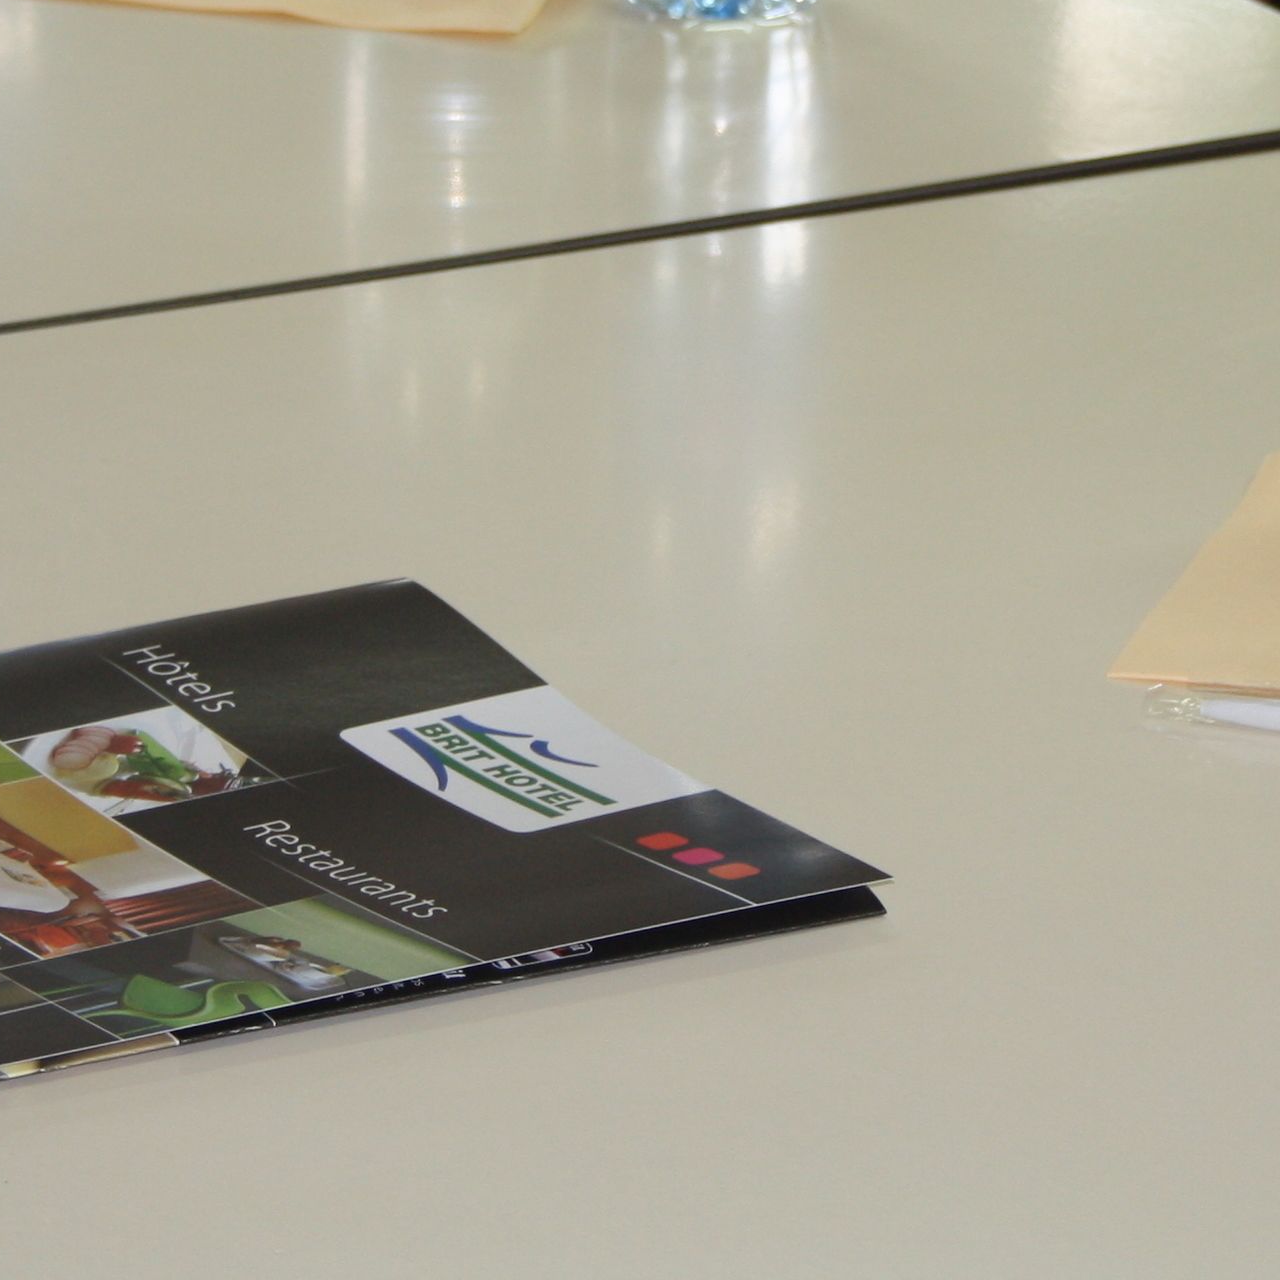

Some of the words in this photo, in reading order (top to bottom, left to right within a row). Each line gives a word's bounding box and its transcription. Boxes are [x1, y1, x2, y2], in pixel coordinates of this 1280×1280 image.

[122, 644, 236, 714] Hôtels
[414, 722, 495, 772] BRIT
[482, 758, 587, 812] HOTEL
[243, 819, 449, 920] Restaurants
